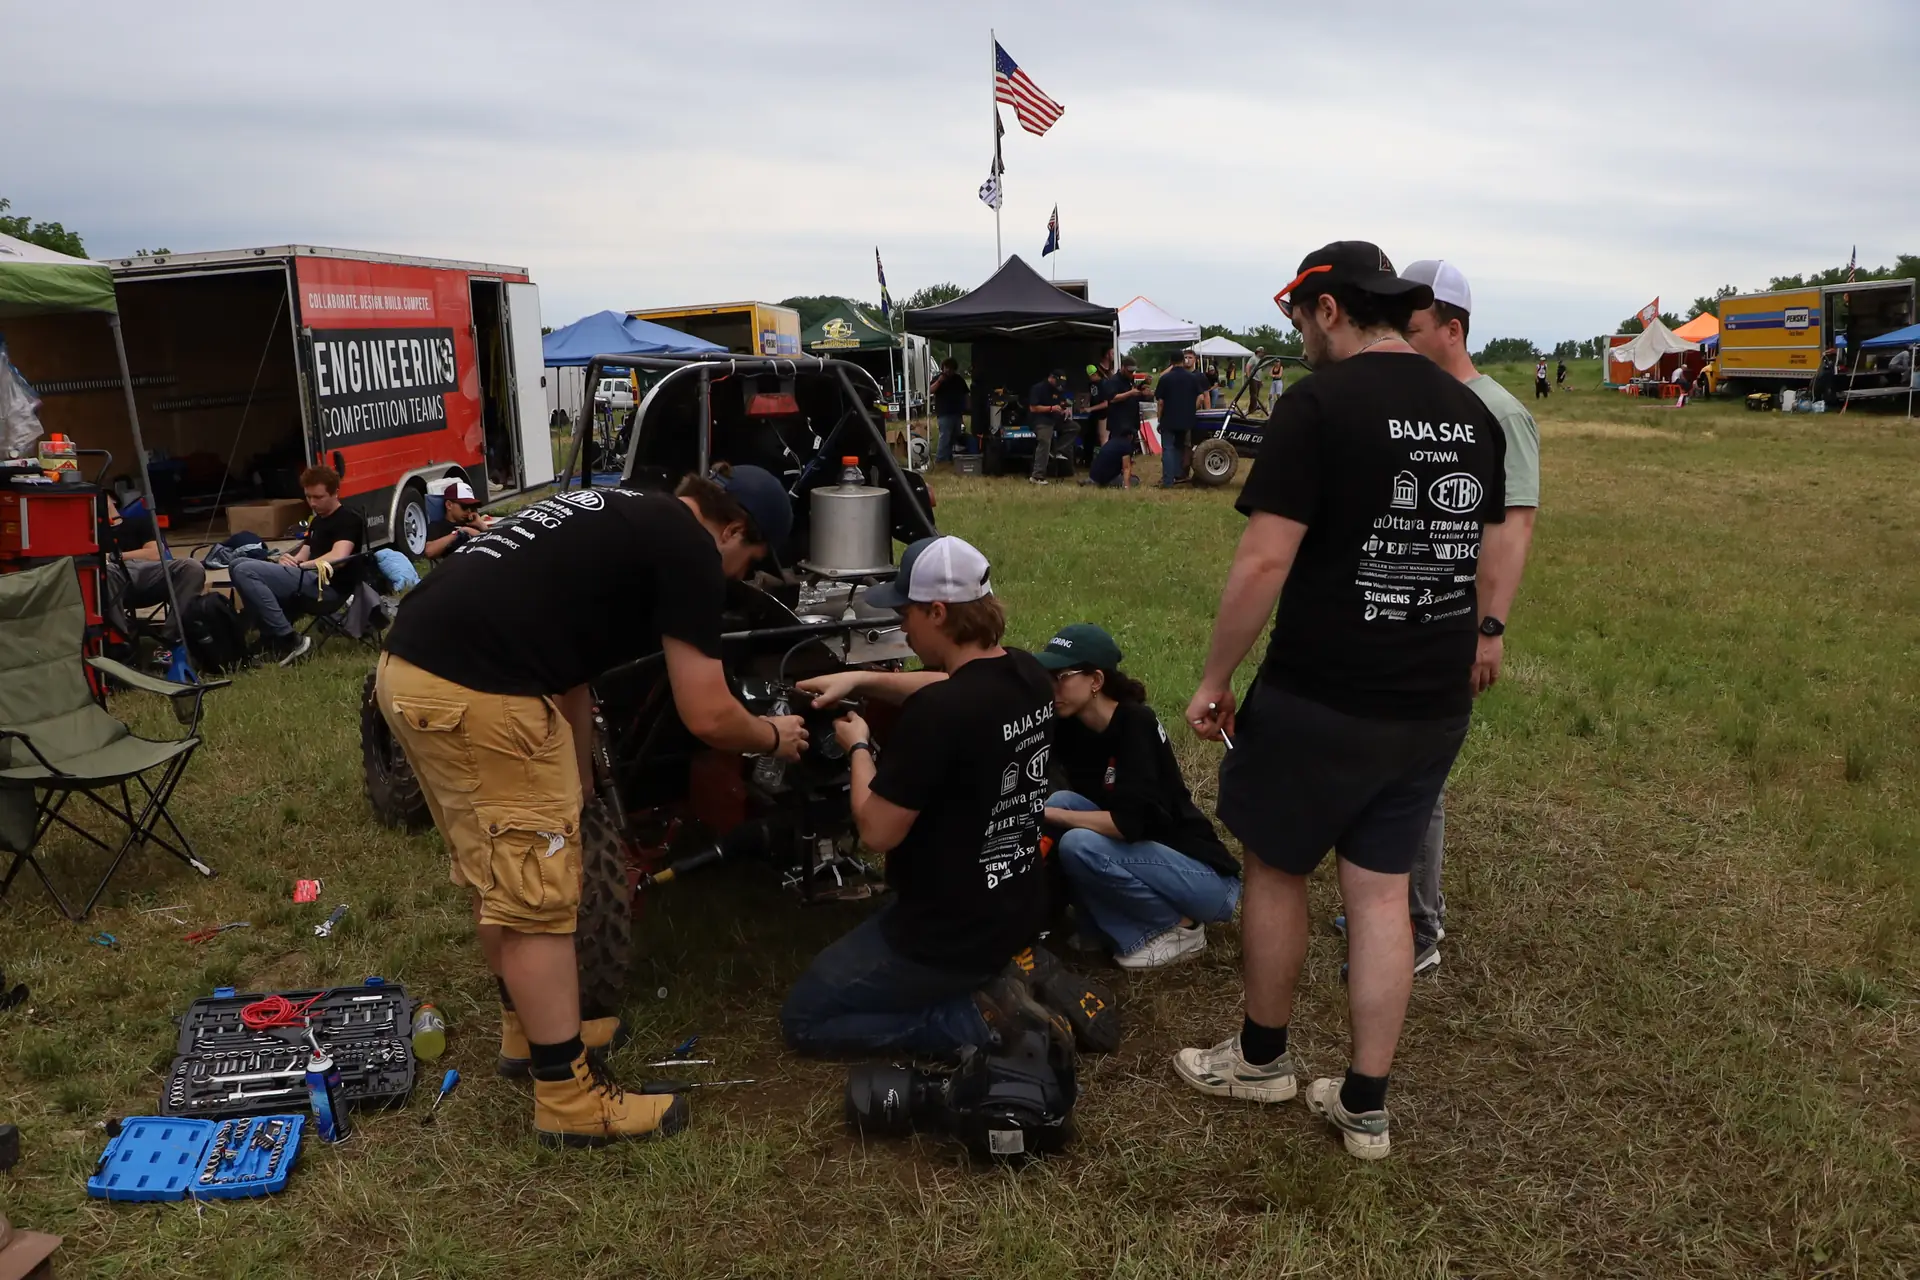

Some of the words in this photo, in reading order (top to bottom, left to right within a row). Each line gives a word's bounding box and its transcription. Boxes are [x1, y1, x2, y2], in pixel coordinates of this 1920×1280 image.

[1786, 314, 1807, 323] PENSKE
[314, 338, 455, 397] ENGINEERING
[408, 394, 444, 423] TEAMS
[1388, 419, 1438, 442] BAJA
[1439, 422, 1476, 444] SAE
[1429, 521, 1452, 531] ETBO
[1409, 565, 1443, 573] MANAGEMENT
[1416, 575, 1432, 583] Capital
[1364, 590, 1411, 605] SIEMENS
[1003, 713, 1034, 742] BAJA
[1034, 700, 1054, 726] SAE
[985, 860, 1012, 874] SIEM
